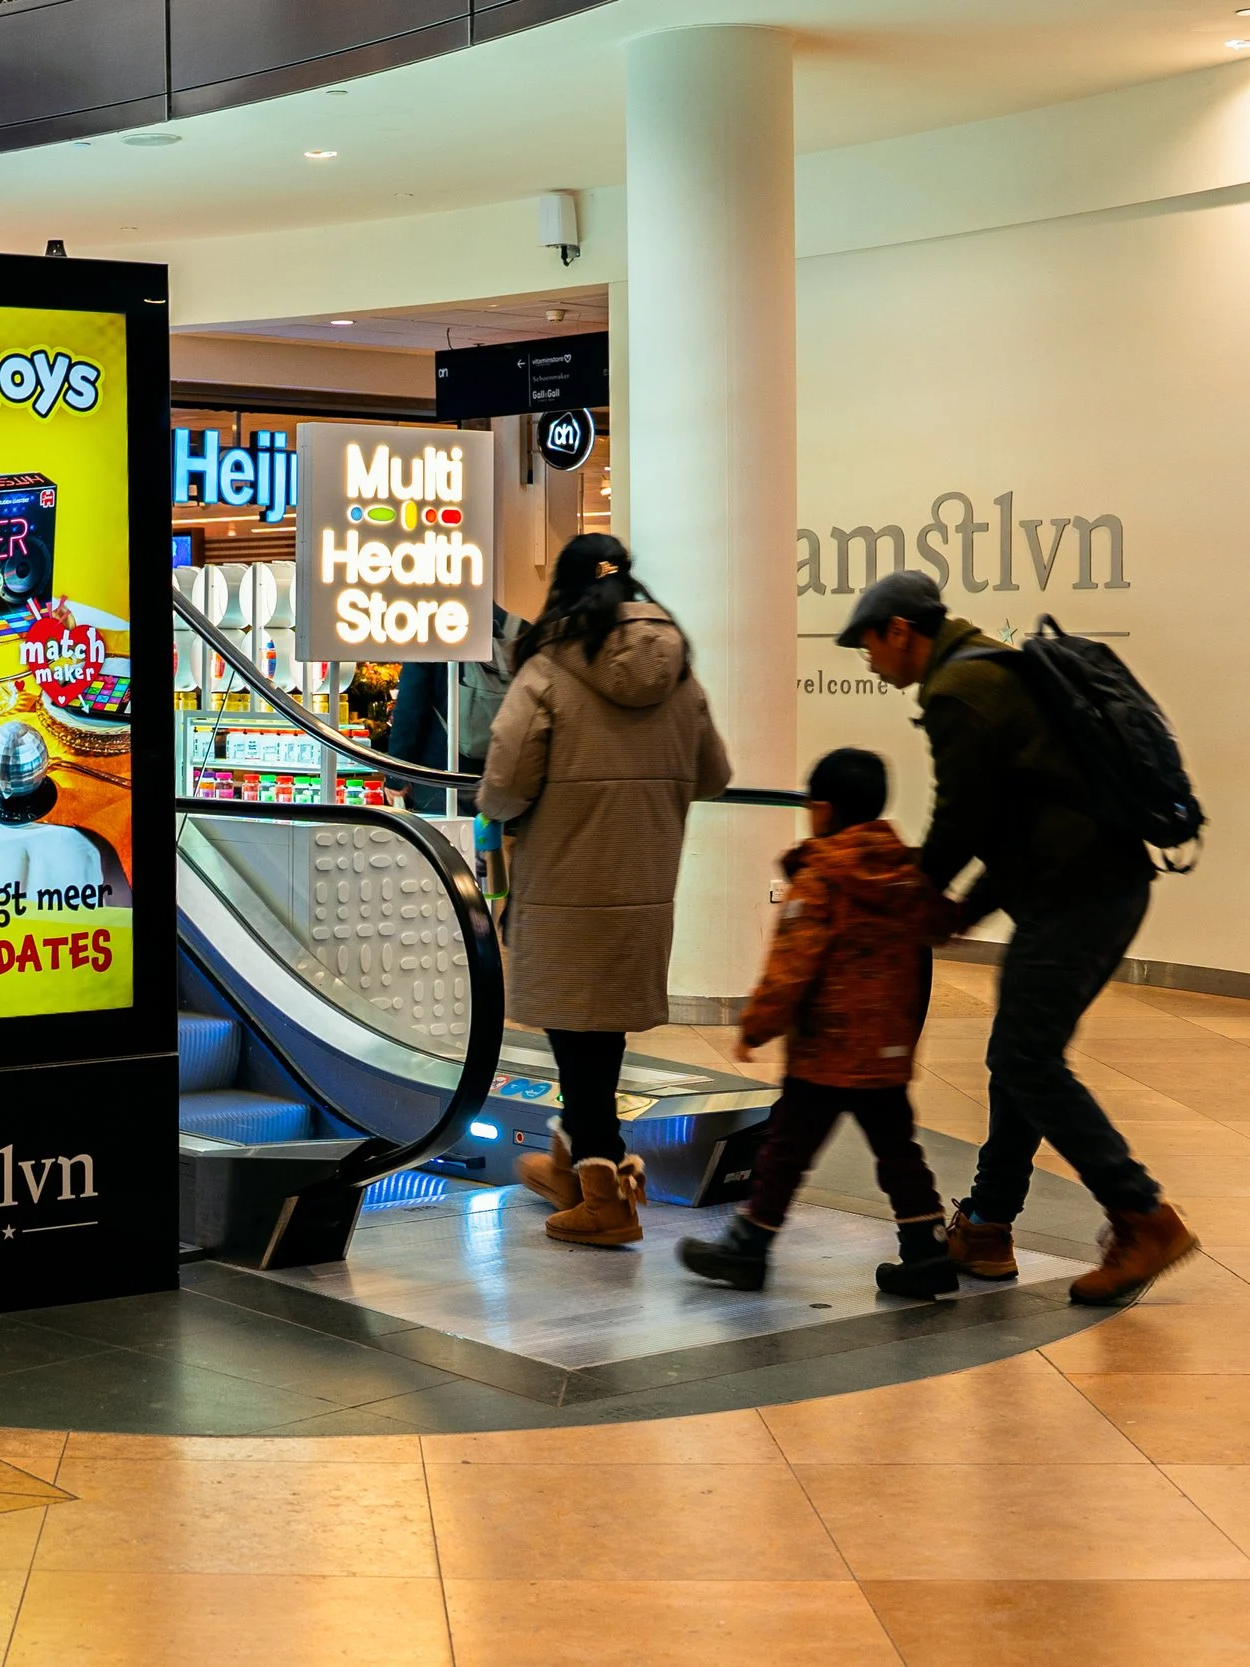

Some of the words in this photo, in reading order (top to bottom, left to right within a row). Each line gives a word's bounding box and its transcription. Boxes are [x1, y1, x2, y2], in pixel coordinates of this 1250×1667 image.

[532, 373, 570, 383] Schoenmaker
[347, 443, 463, 502] Multi
[321, 529, 484, 586] Health
[335, 588, 469, 643] Store
[19, 627, 106, 665] match
[35, 664, 95, 684] maker
[36, 883, 113, 911] meer
